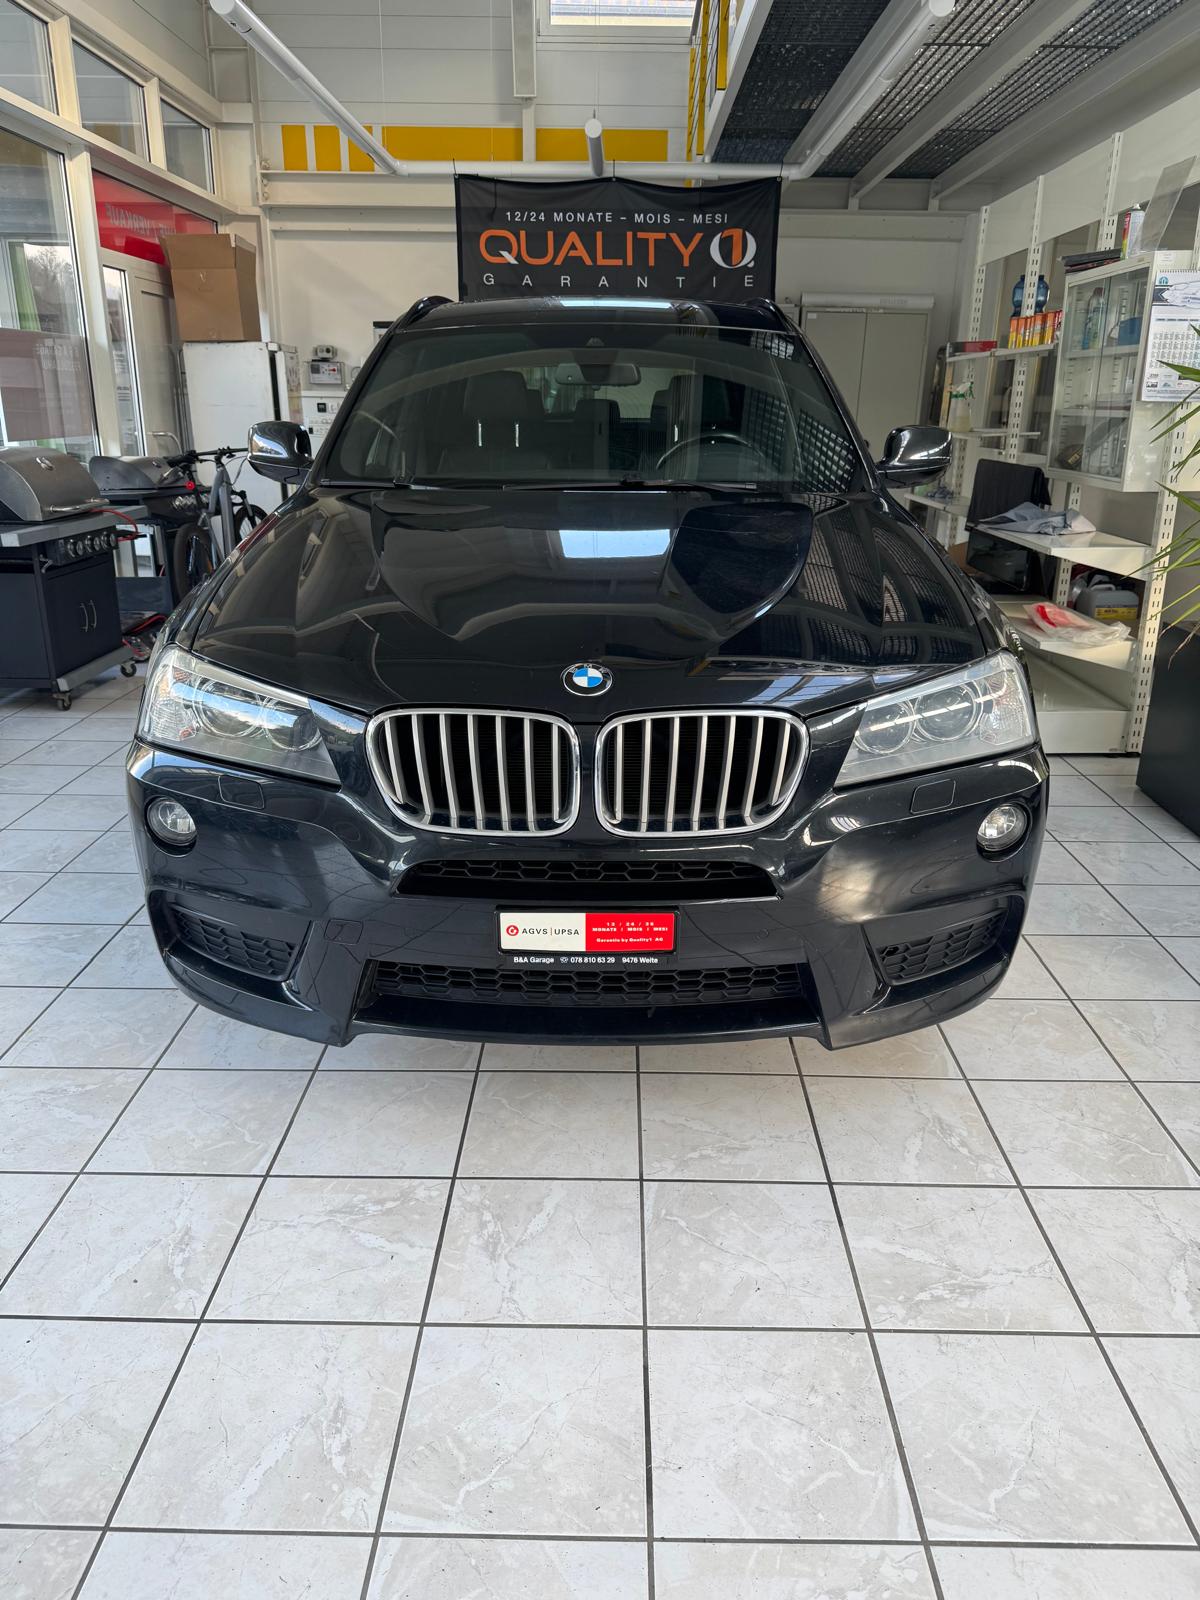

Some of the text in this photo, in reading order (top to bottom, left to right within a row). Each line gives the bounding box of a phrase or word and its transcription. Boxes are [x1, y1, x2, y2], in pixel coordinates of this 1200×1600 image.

[506, 211, 545, 222] 12/24
[553, 212, 613, 223] MONATE
[634, 213, 671, 224] MOIS
[693, 213, 728, 224] MESI
[479, 229, 703, 267] QUALITY
[483, 273, 754, 289] GARANTIE
[521, 928, 581, 937] AGVS UPSA
[513, 956, 529, 964] B&A
[529, 956, 555, 965] Garage
[570, 956, 583, 964] 078
[583, 956, 596, 964] 810
[596, 956, 606, 964] 63
[606, 956, 616, 964] 29
[639, 956, 659, 964] Weite
